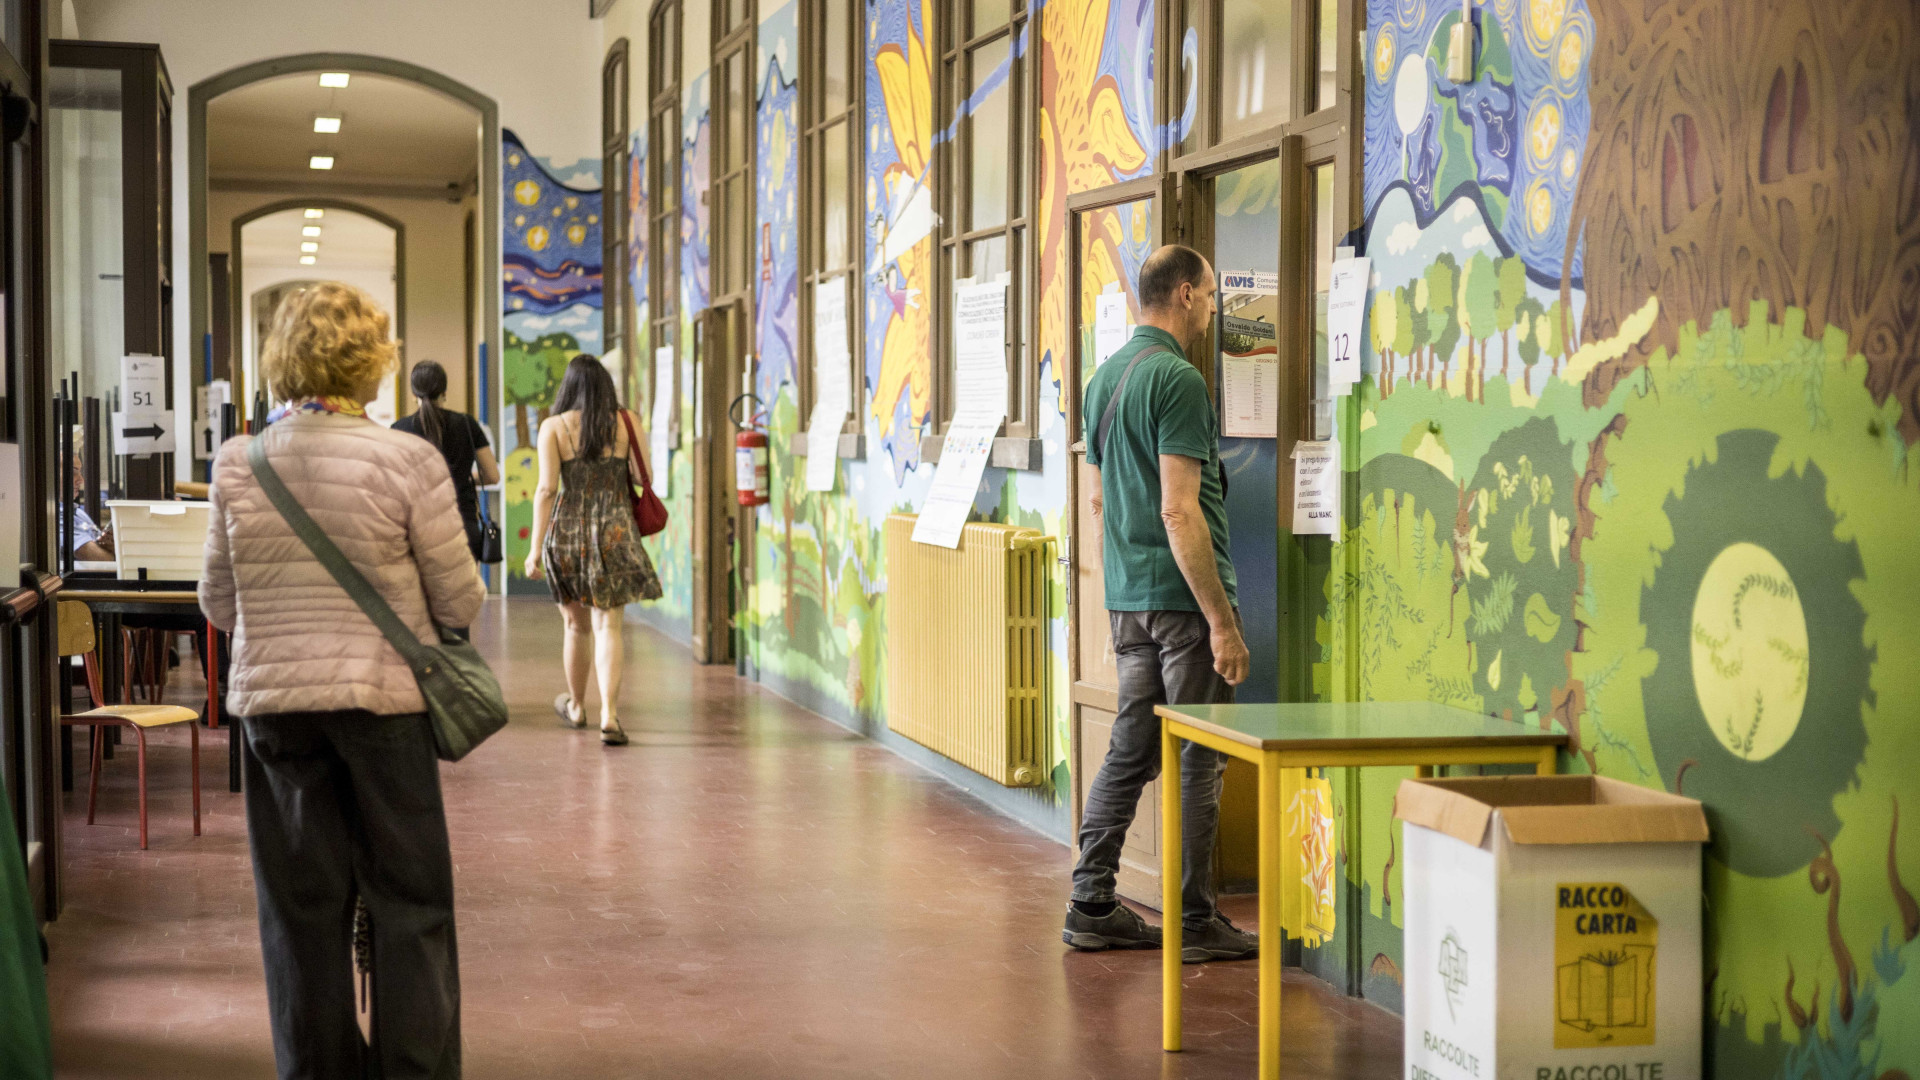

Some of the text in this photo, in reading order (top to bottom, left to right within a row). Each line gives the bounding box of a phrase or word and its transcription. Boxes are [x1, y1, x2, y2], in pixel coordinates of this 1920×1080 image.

[1225, 276, 1254, 288] AVIS
[1227, 321, 1250, 331] Osvaldo
[1335, 333, 1350, 361] 12
[133, 392, 153, 406] 51
[1308, 511, 1318, 519] ALLA
[1559, 886, 1624, 909] RACCO
[1576, 913, 1638, 935] CARTA
[1424, 1030, 1480, 1078] RACCOLTE
[1536, 1062, 1664, 1080] RACCOLTE
